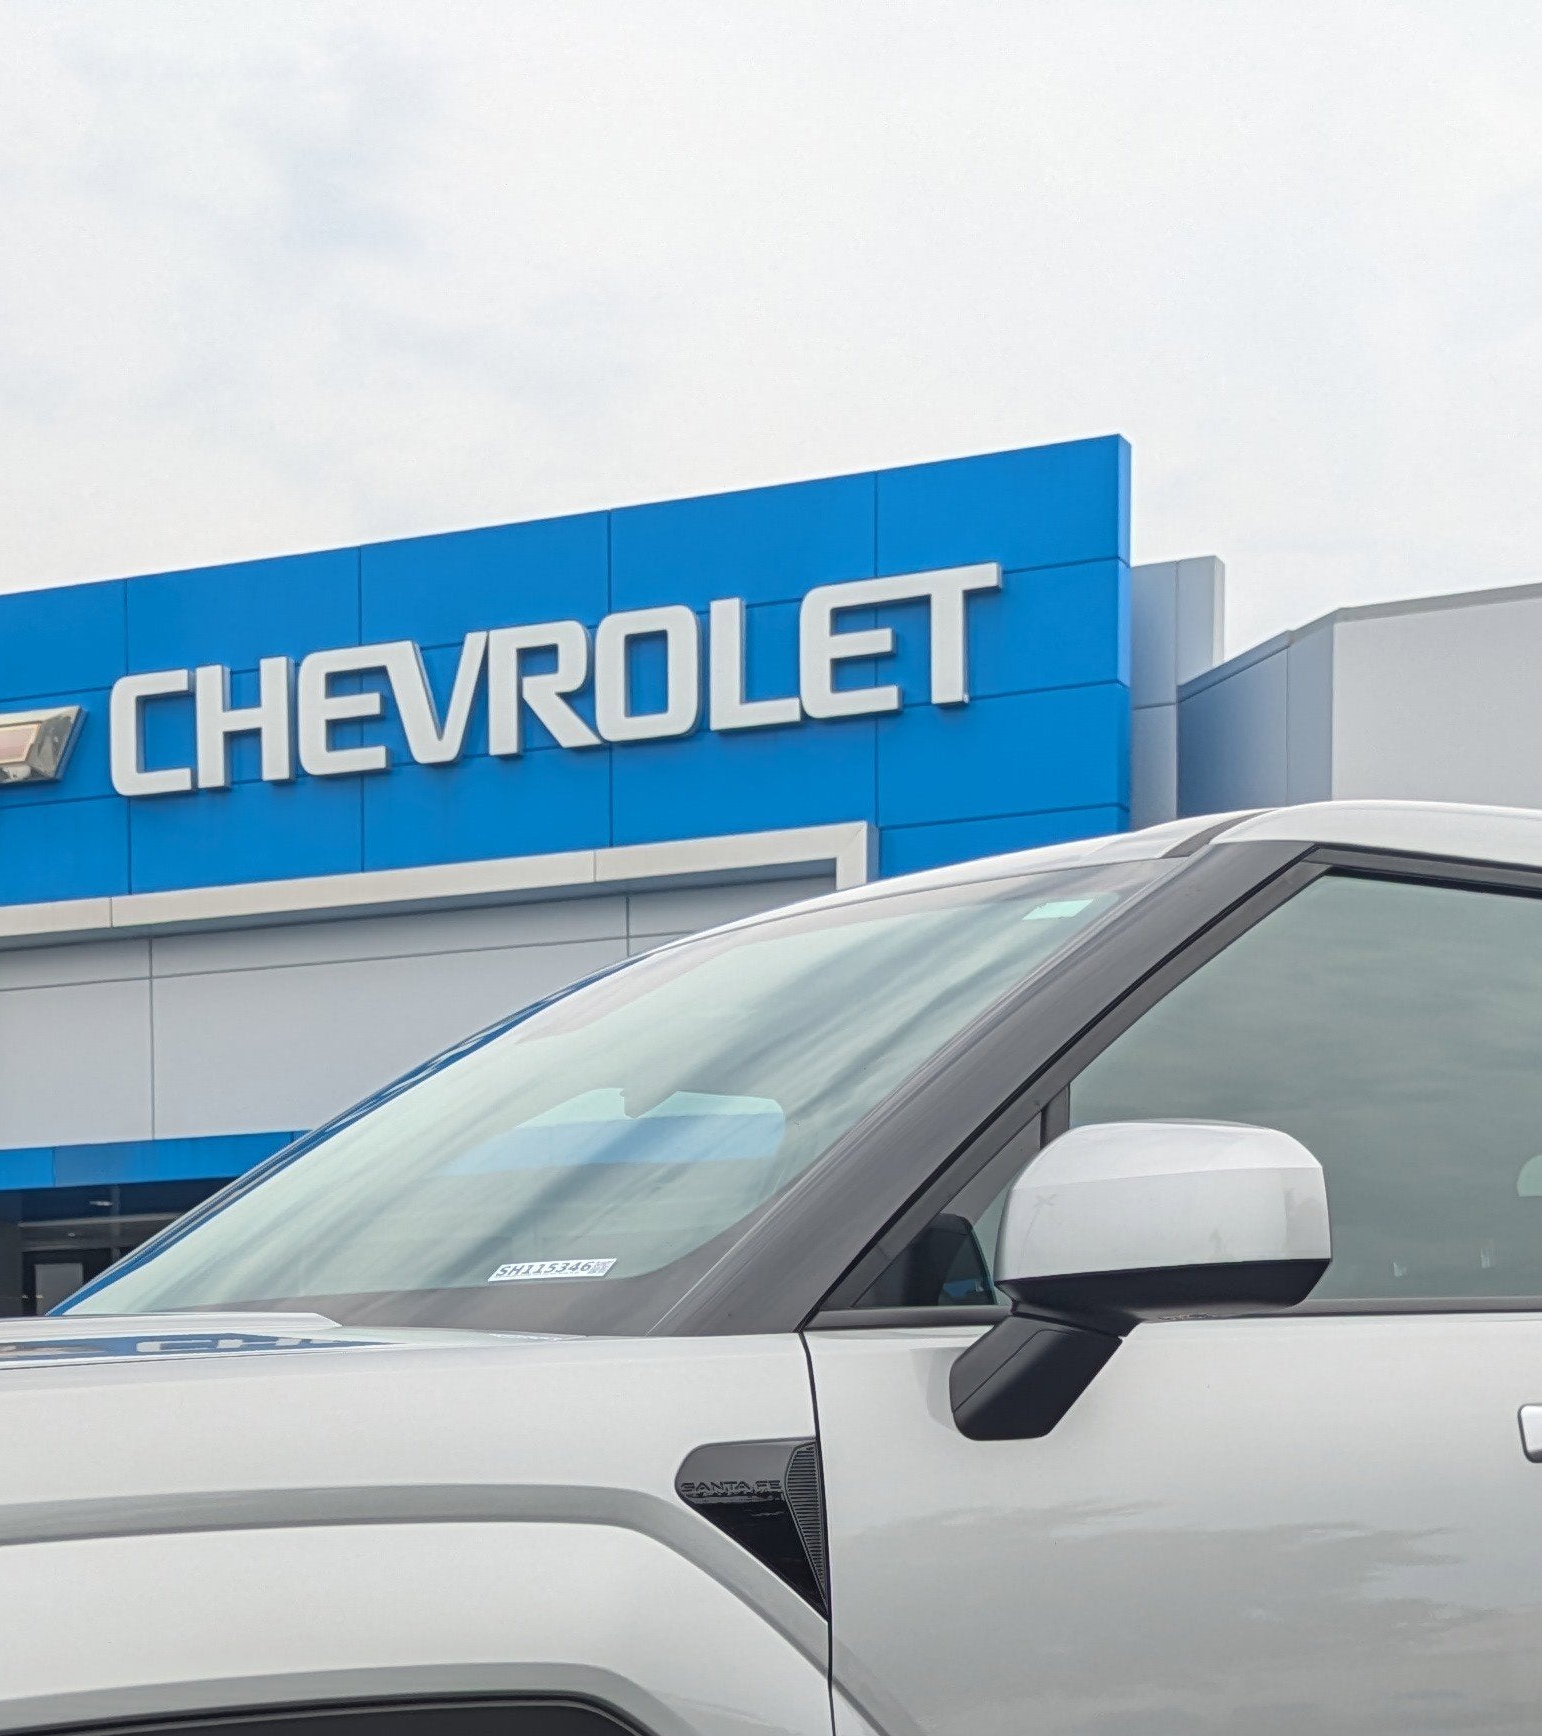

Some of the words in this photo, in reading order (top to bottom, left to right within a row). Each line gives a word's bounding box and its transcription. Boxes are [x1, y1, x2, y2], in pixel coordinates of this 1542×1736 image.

[110, 561, 1002, 798] CHEVROLET
[681, 1480, 751, 1493] SANTA
[755, 1479, 781, 1491] FE
